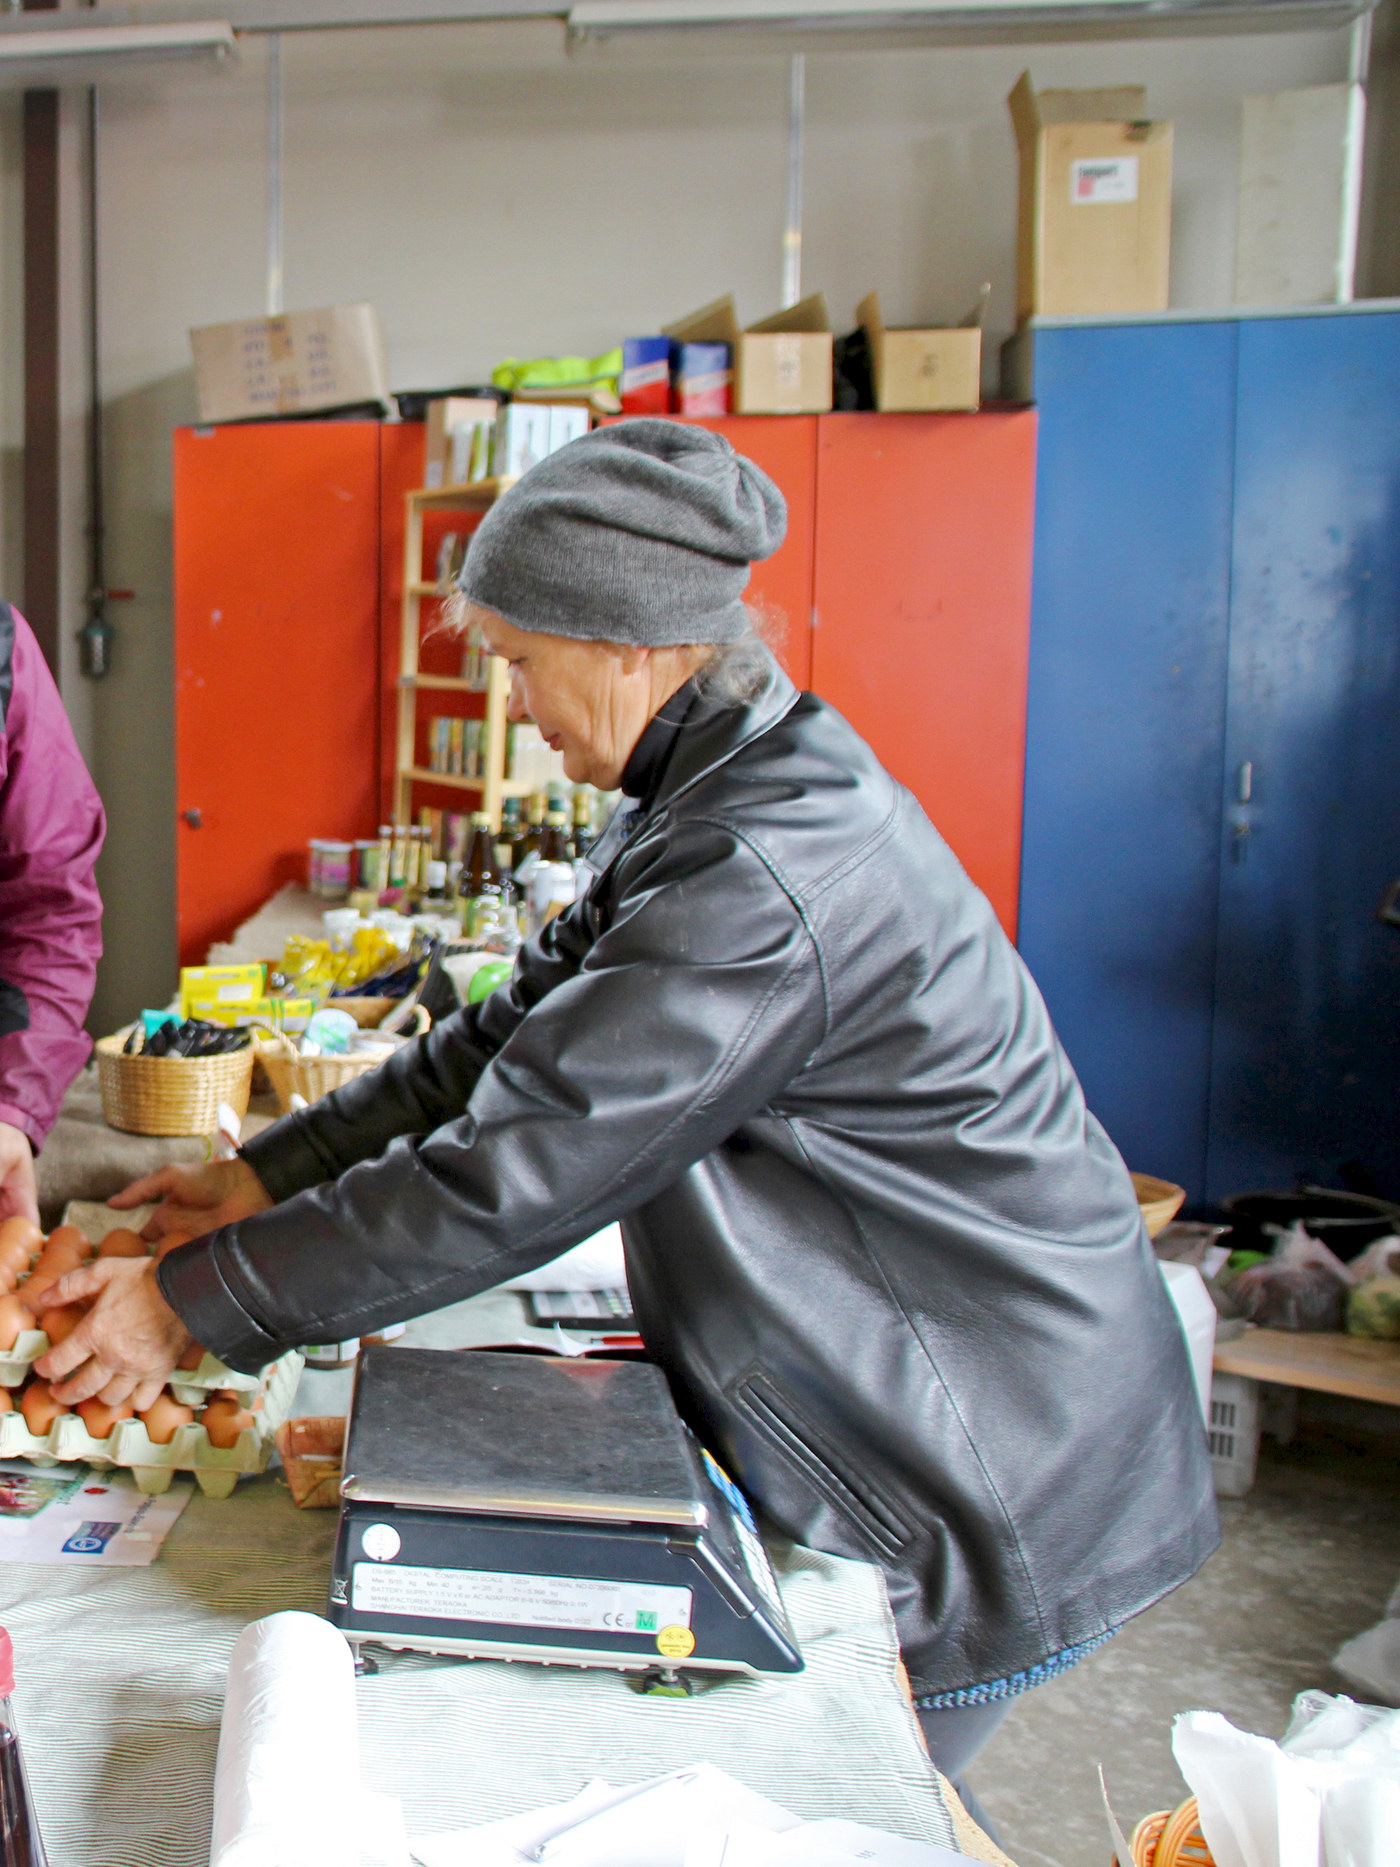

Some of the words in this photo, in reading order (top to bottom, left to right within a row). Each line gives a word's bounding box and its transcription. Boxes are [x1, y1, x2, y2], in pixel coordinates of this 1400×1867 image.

[404, 1570, 431, 1578] DIGITAL
[435, 1572, 479, 1581] COMPUTING
[371, 1586, 403, 1594] BATTERY
[406, 1588, 433, 1596] SUPPLY
[486, 1594, 519, 1602] ADAPTOR
[370, 1602, 407, 1610] SHANGHAI
[409, 1605, 442, 1613] TERAOKA
[444, 1608, 490, 1618] ELECTRONIC
[433, 1599, 468, 1607] TERAOKA
[603, 1612, 624, 1627] CE
